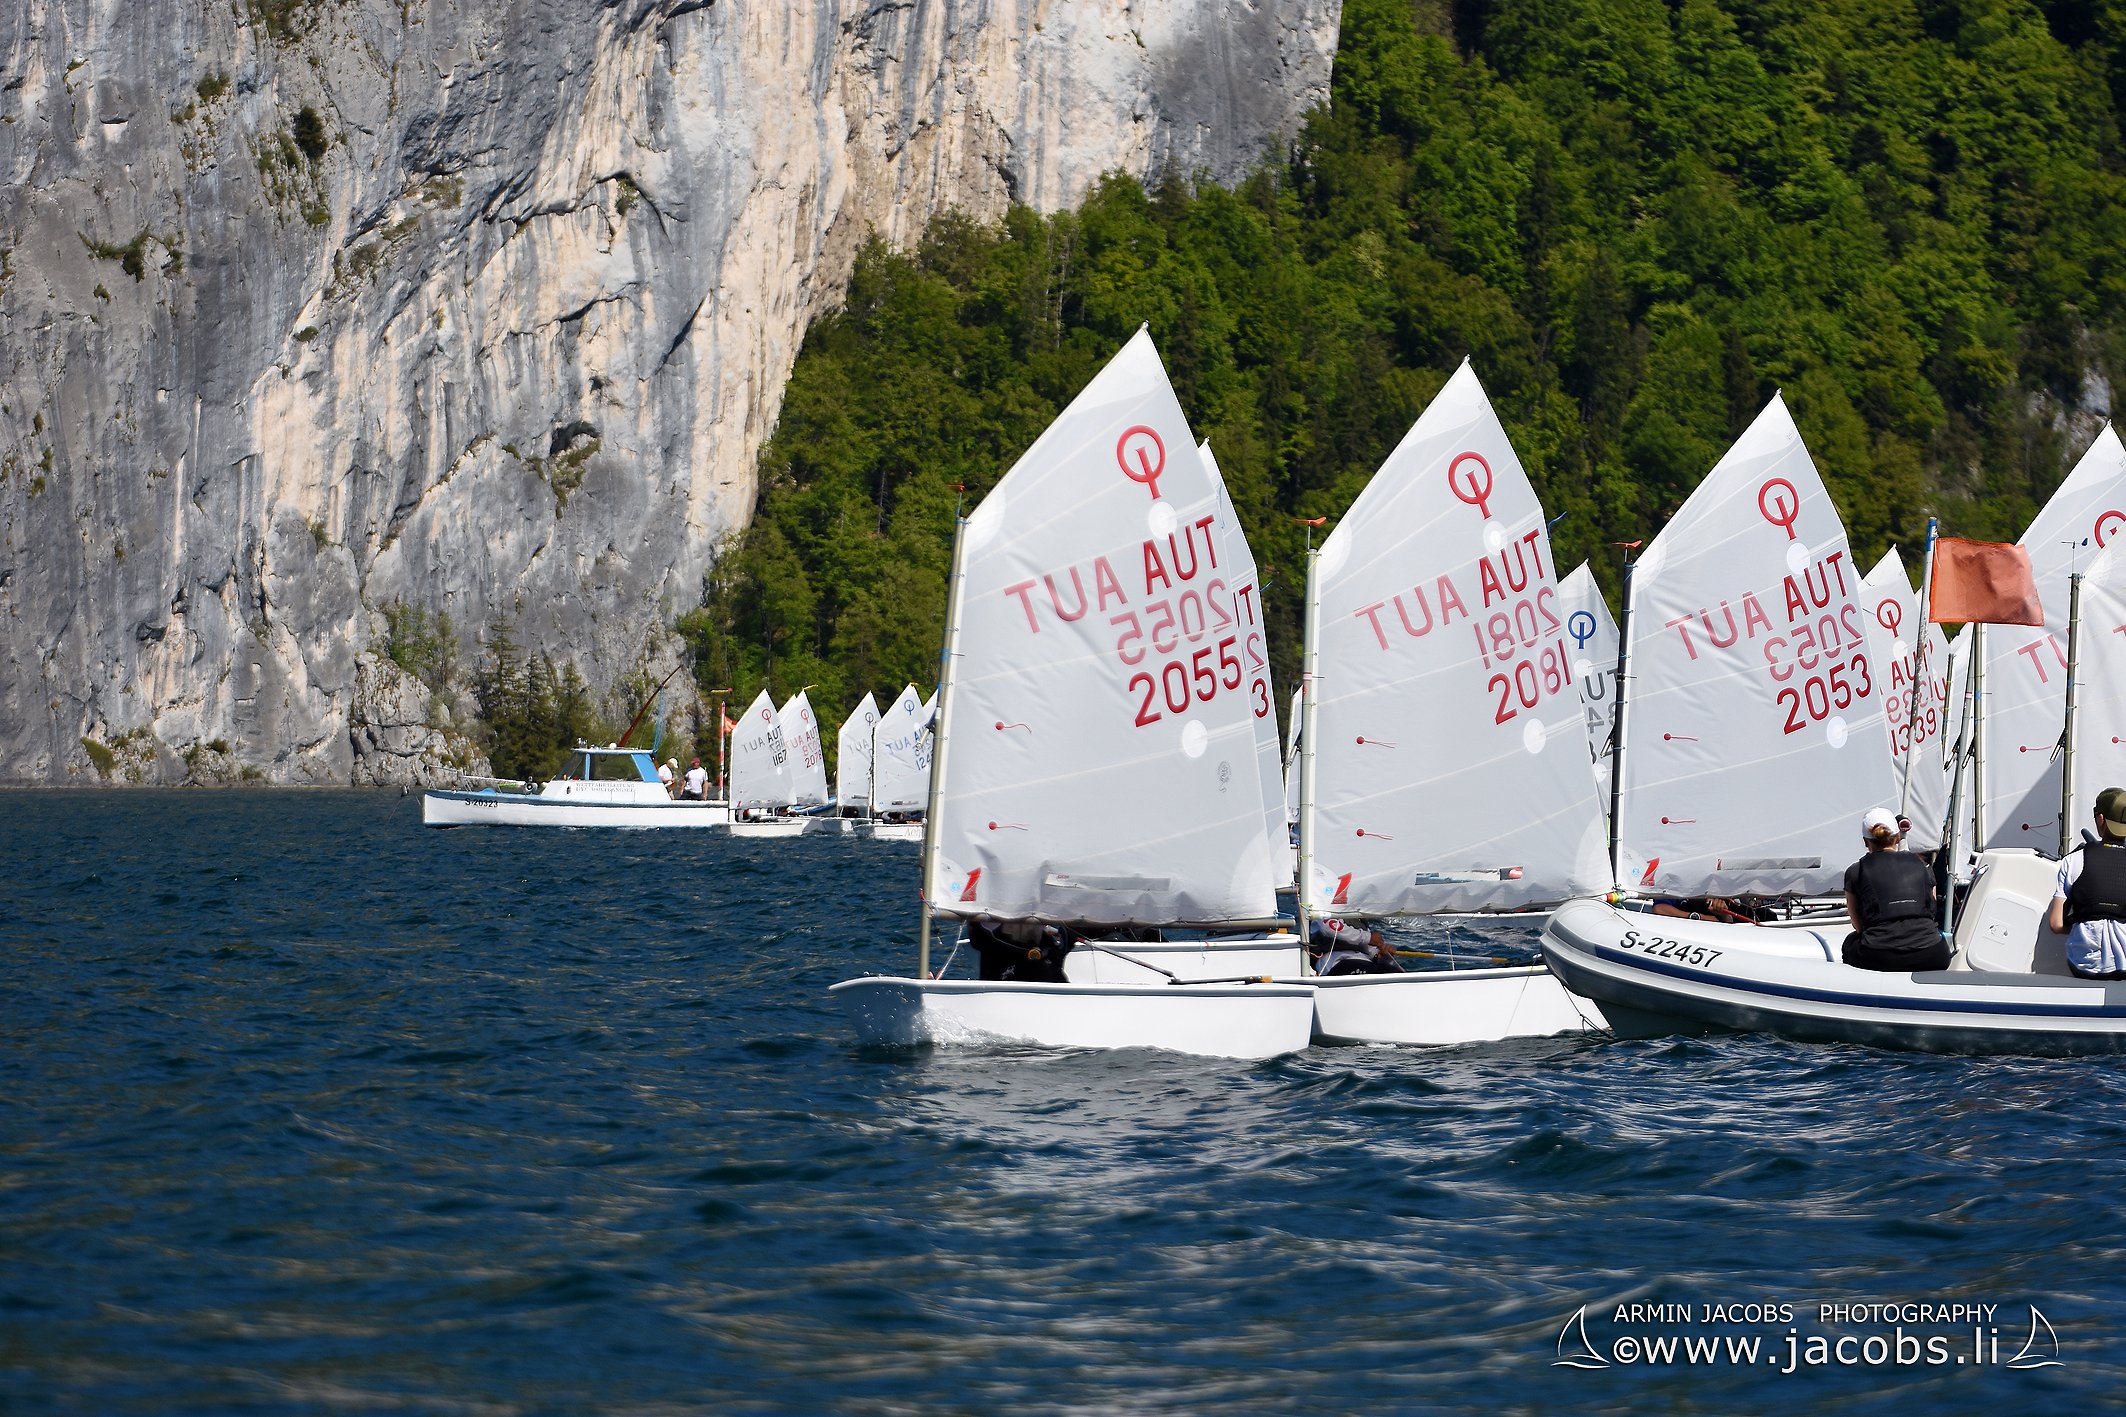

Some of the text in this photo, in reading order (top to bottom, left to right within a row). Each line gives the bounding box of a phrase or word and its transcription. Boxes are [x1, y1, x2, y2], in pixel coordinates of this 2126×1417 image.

[1142, 514, 1218, 596] AUT
[1478, 528, 1545, 609] AUT
[1783, 551, 1848, 623] AUT
[1129, 635, 1242, 728] 2055
[1487, 638, 1573, 725] 2081
[1777, 653, 1873, 735] 2053
[767, 725, 782, 743] AUT
[772, 749, 787, 766] 1167
[805, 725, 818, 742] AUT
[1891, 707, 1937, 756] 1339
[1620, 931, 1723, 968] S-22457
